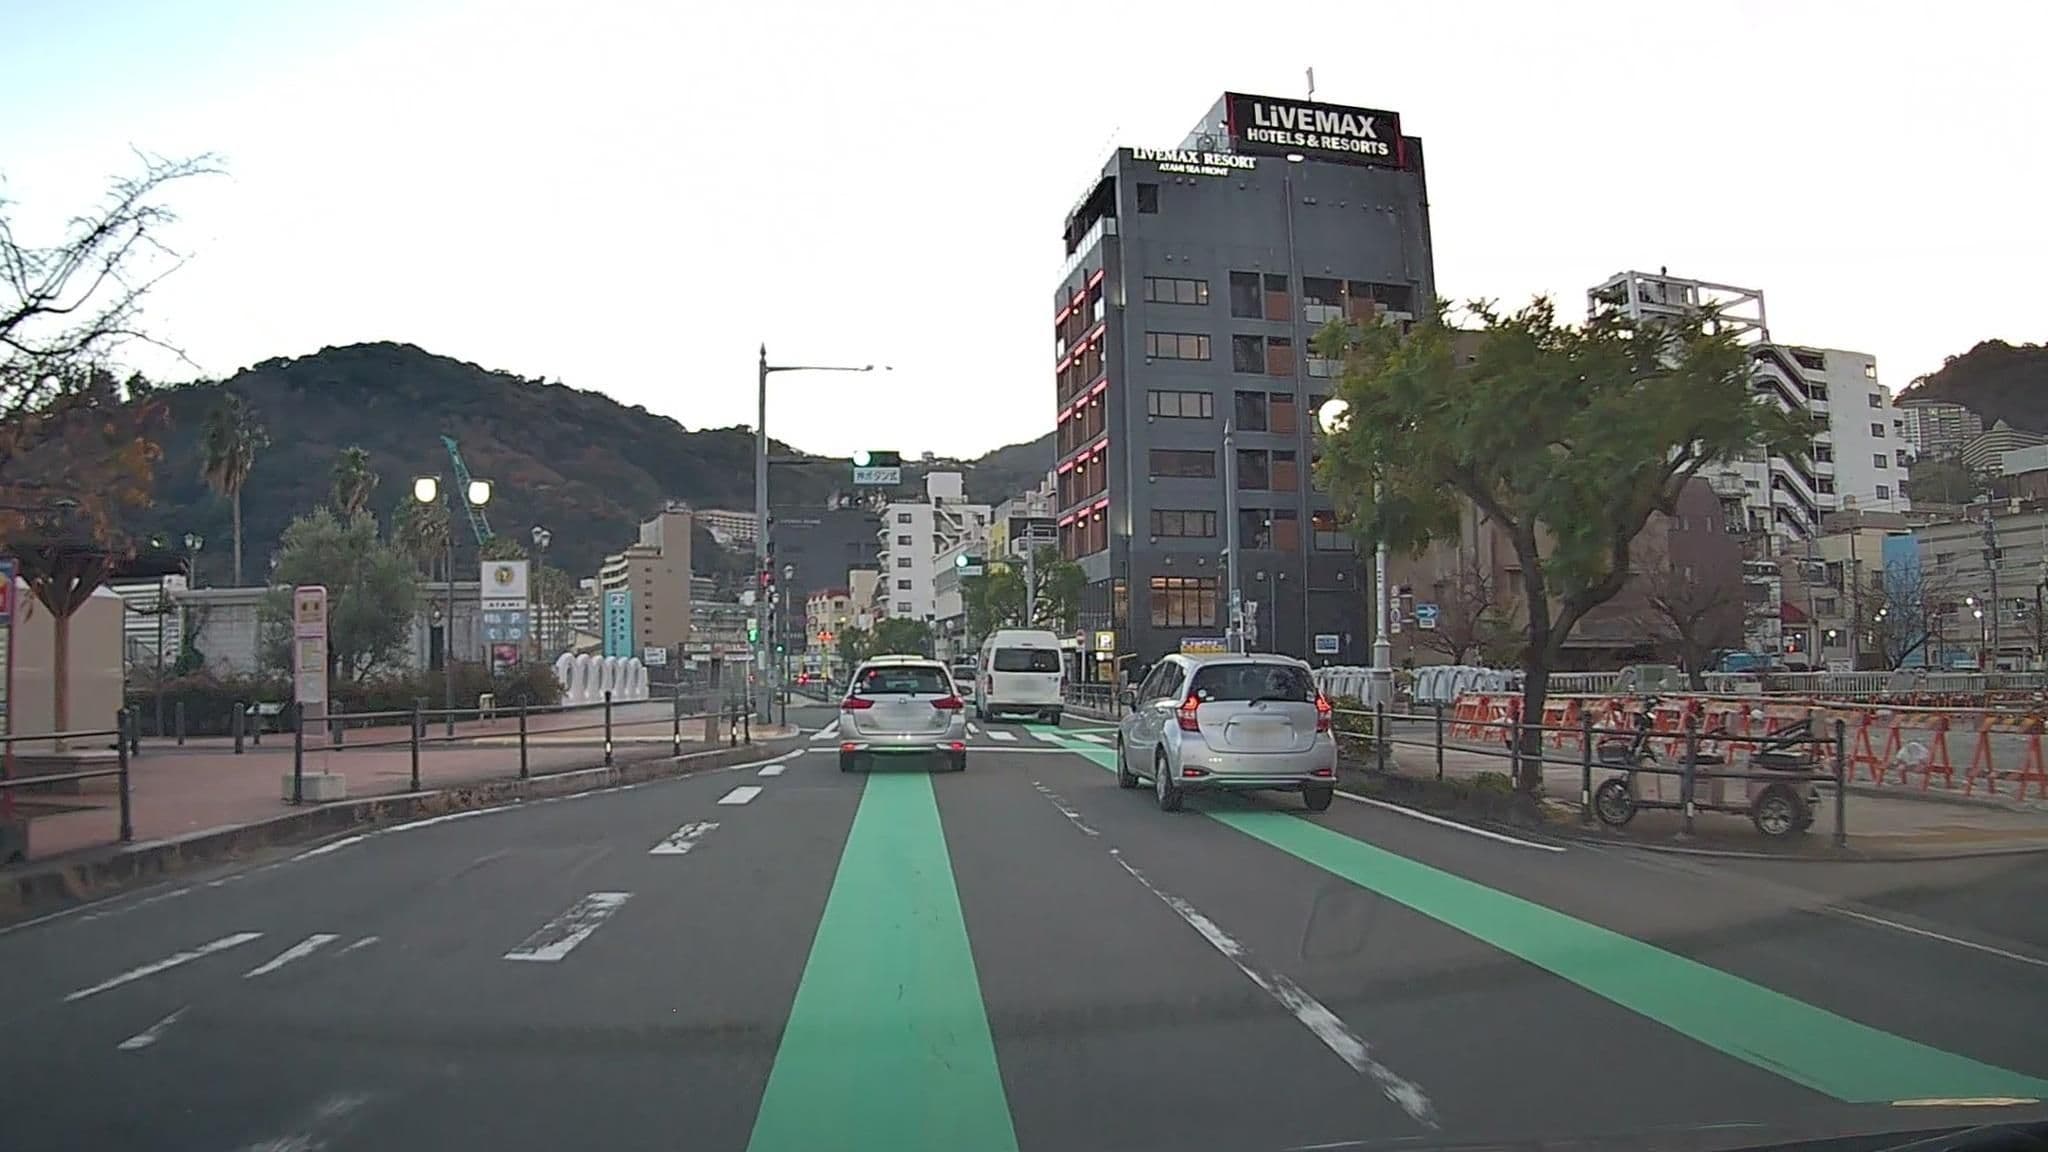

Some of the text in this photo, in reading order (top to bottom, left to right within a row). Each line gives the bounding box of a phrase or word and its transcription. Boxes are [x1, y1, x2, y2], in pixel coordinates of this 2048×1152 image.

[1247, 127, 1305, 146] HOTELS
[1321, 136, 1389, 155] RESORTS
[1203, 153, 1257, 169] RESORT
